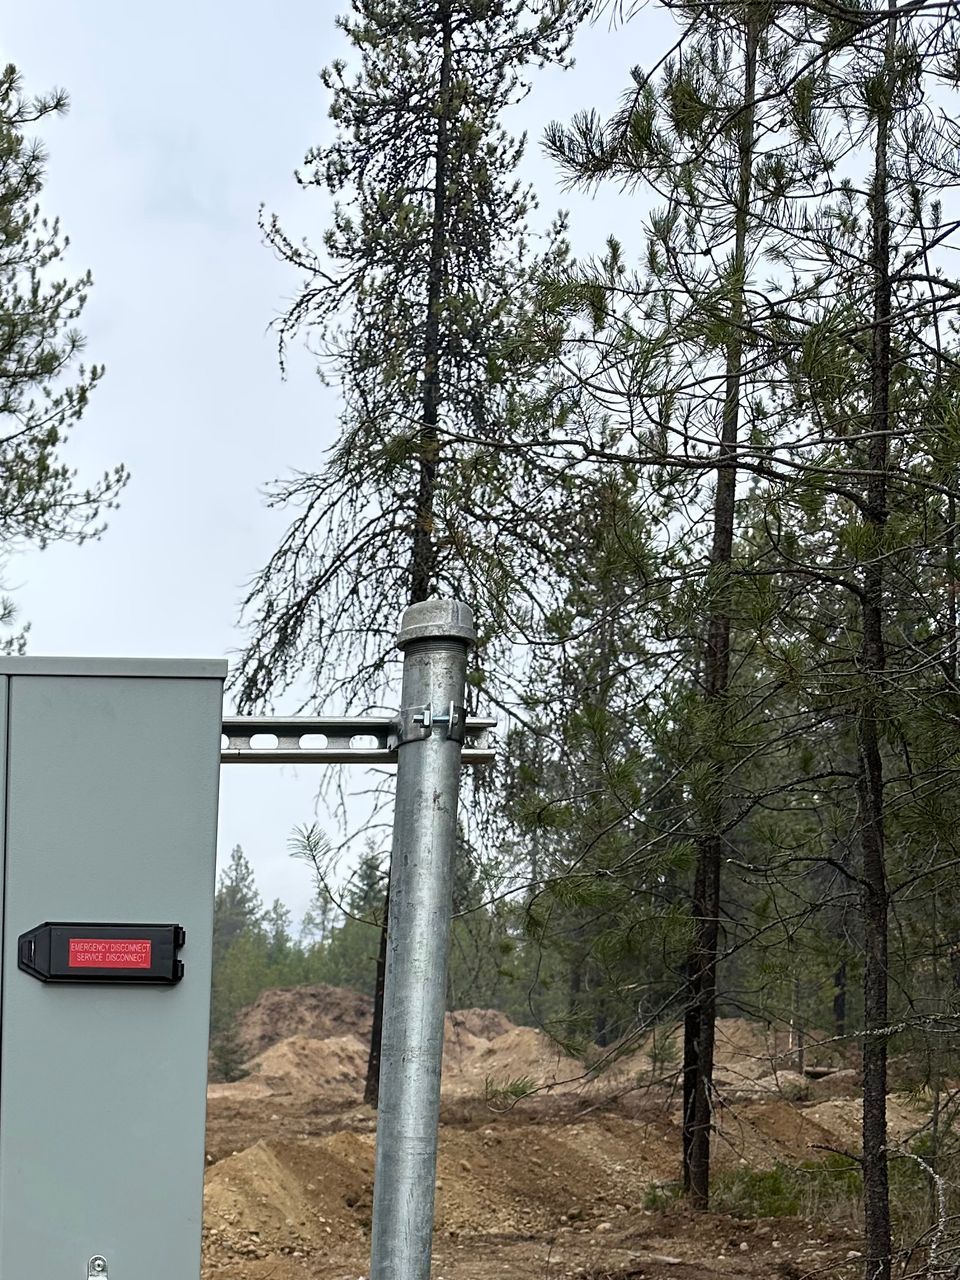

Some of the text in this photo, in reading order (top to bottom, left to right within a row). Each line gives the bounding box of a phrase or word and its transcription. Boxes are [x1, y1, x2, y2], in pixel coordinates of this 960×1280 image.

[71, 943, 150, 952] EMERGENCY DISCONNECT
[77, 953, 103, 961] SERVICE
